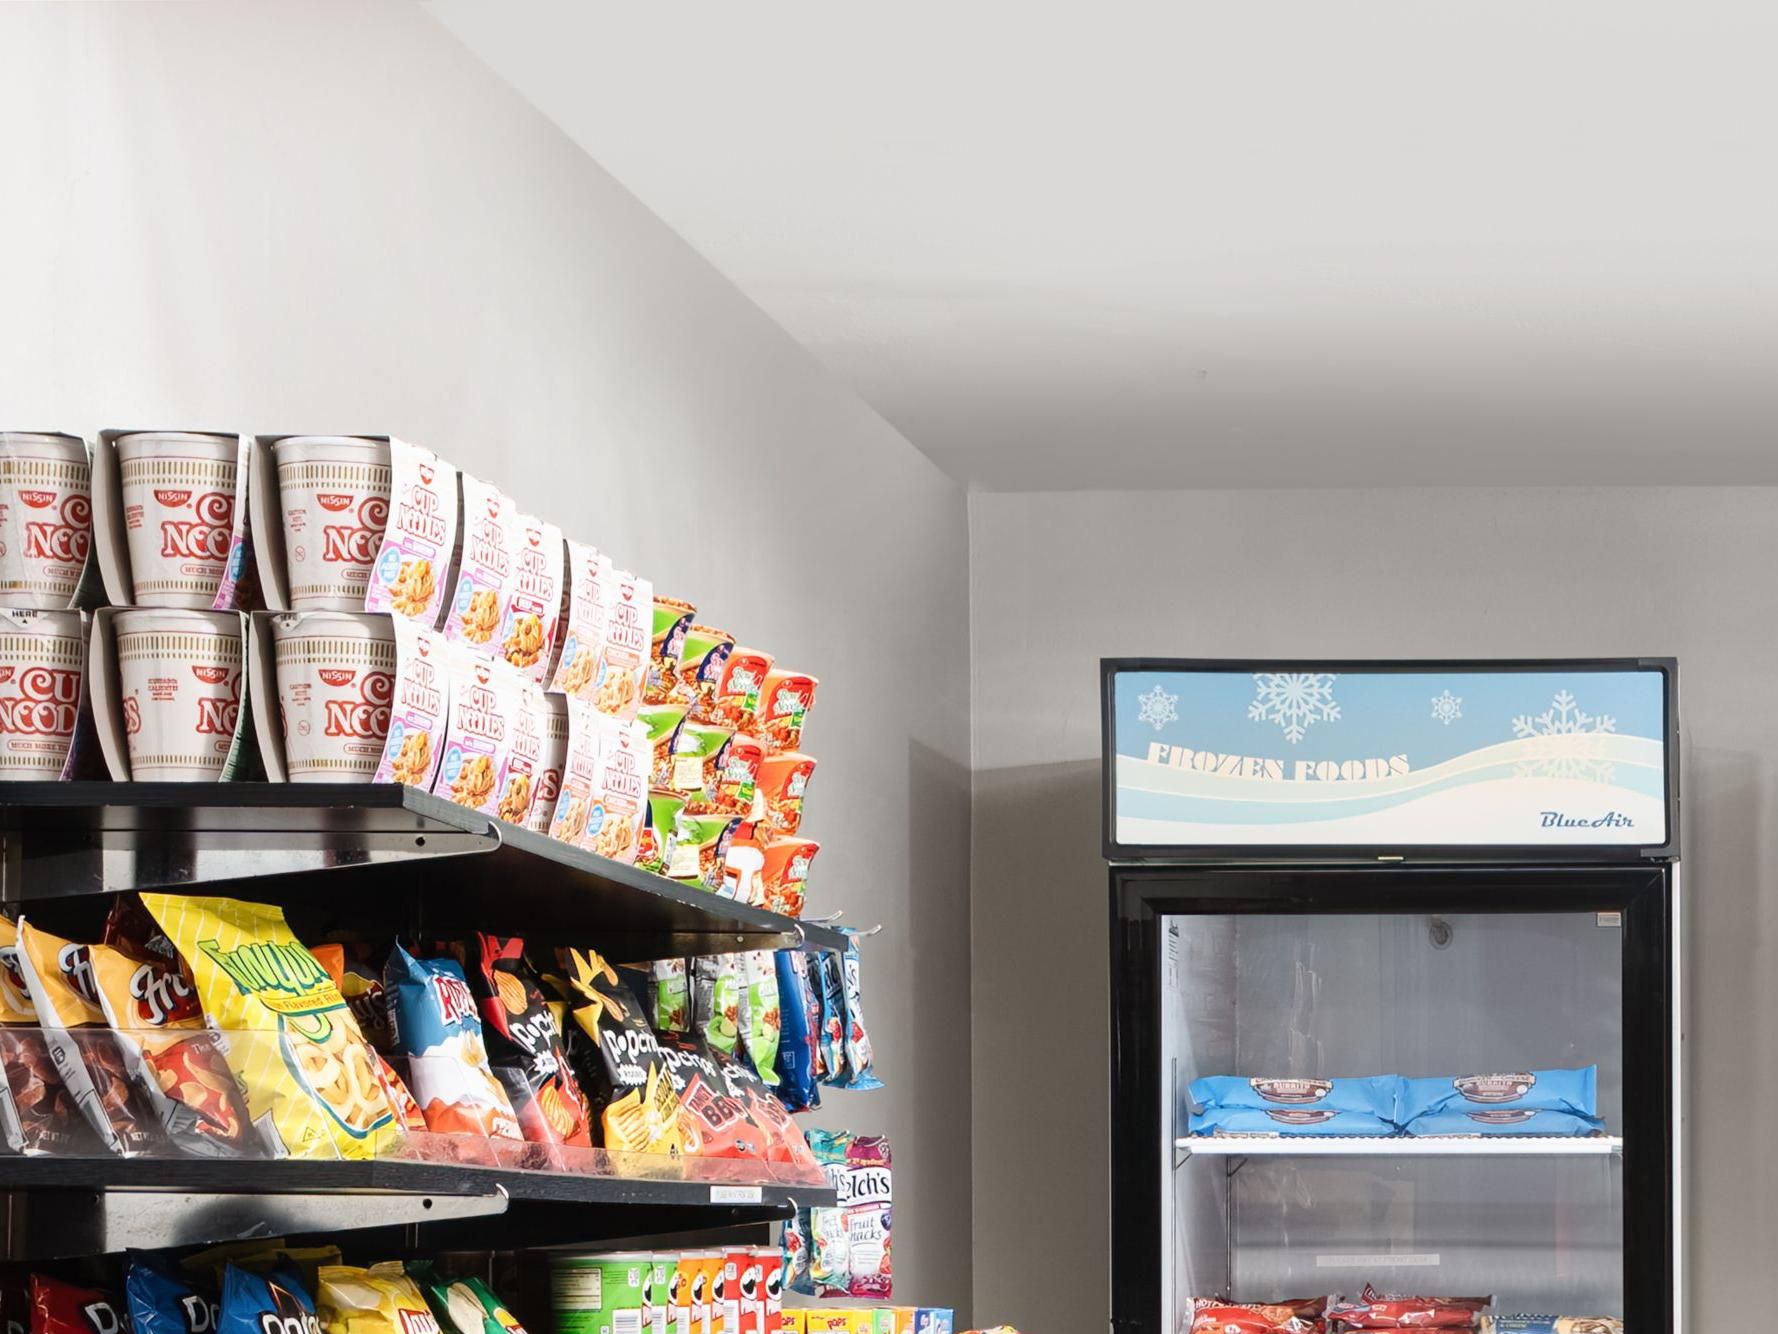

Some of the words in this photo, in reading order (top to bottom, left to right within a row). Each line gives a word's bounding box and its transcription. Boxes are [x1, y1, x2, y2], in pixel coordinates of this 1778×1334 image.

[157, 491, 189, 503] NISSIN
[319, 494, 352, 507] NISSIN
[320, 670, 353, 681] NISSIN
[1147, 742, 1284, 781] FROZEN
[1294, 753, 1411, 781] FOODS
[850, 1228, 882, 1242] nacks
[827, 1316, 847, 1331] POPS
